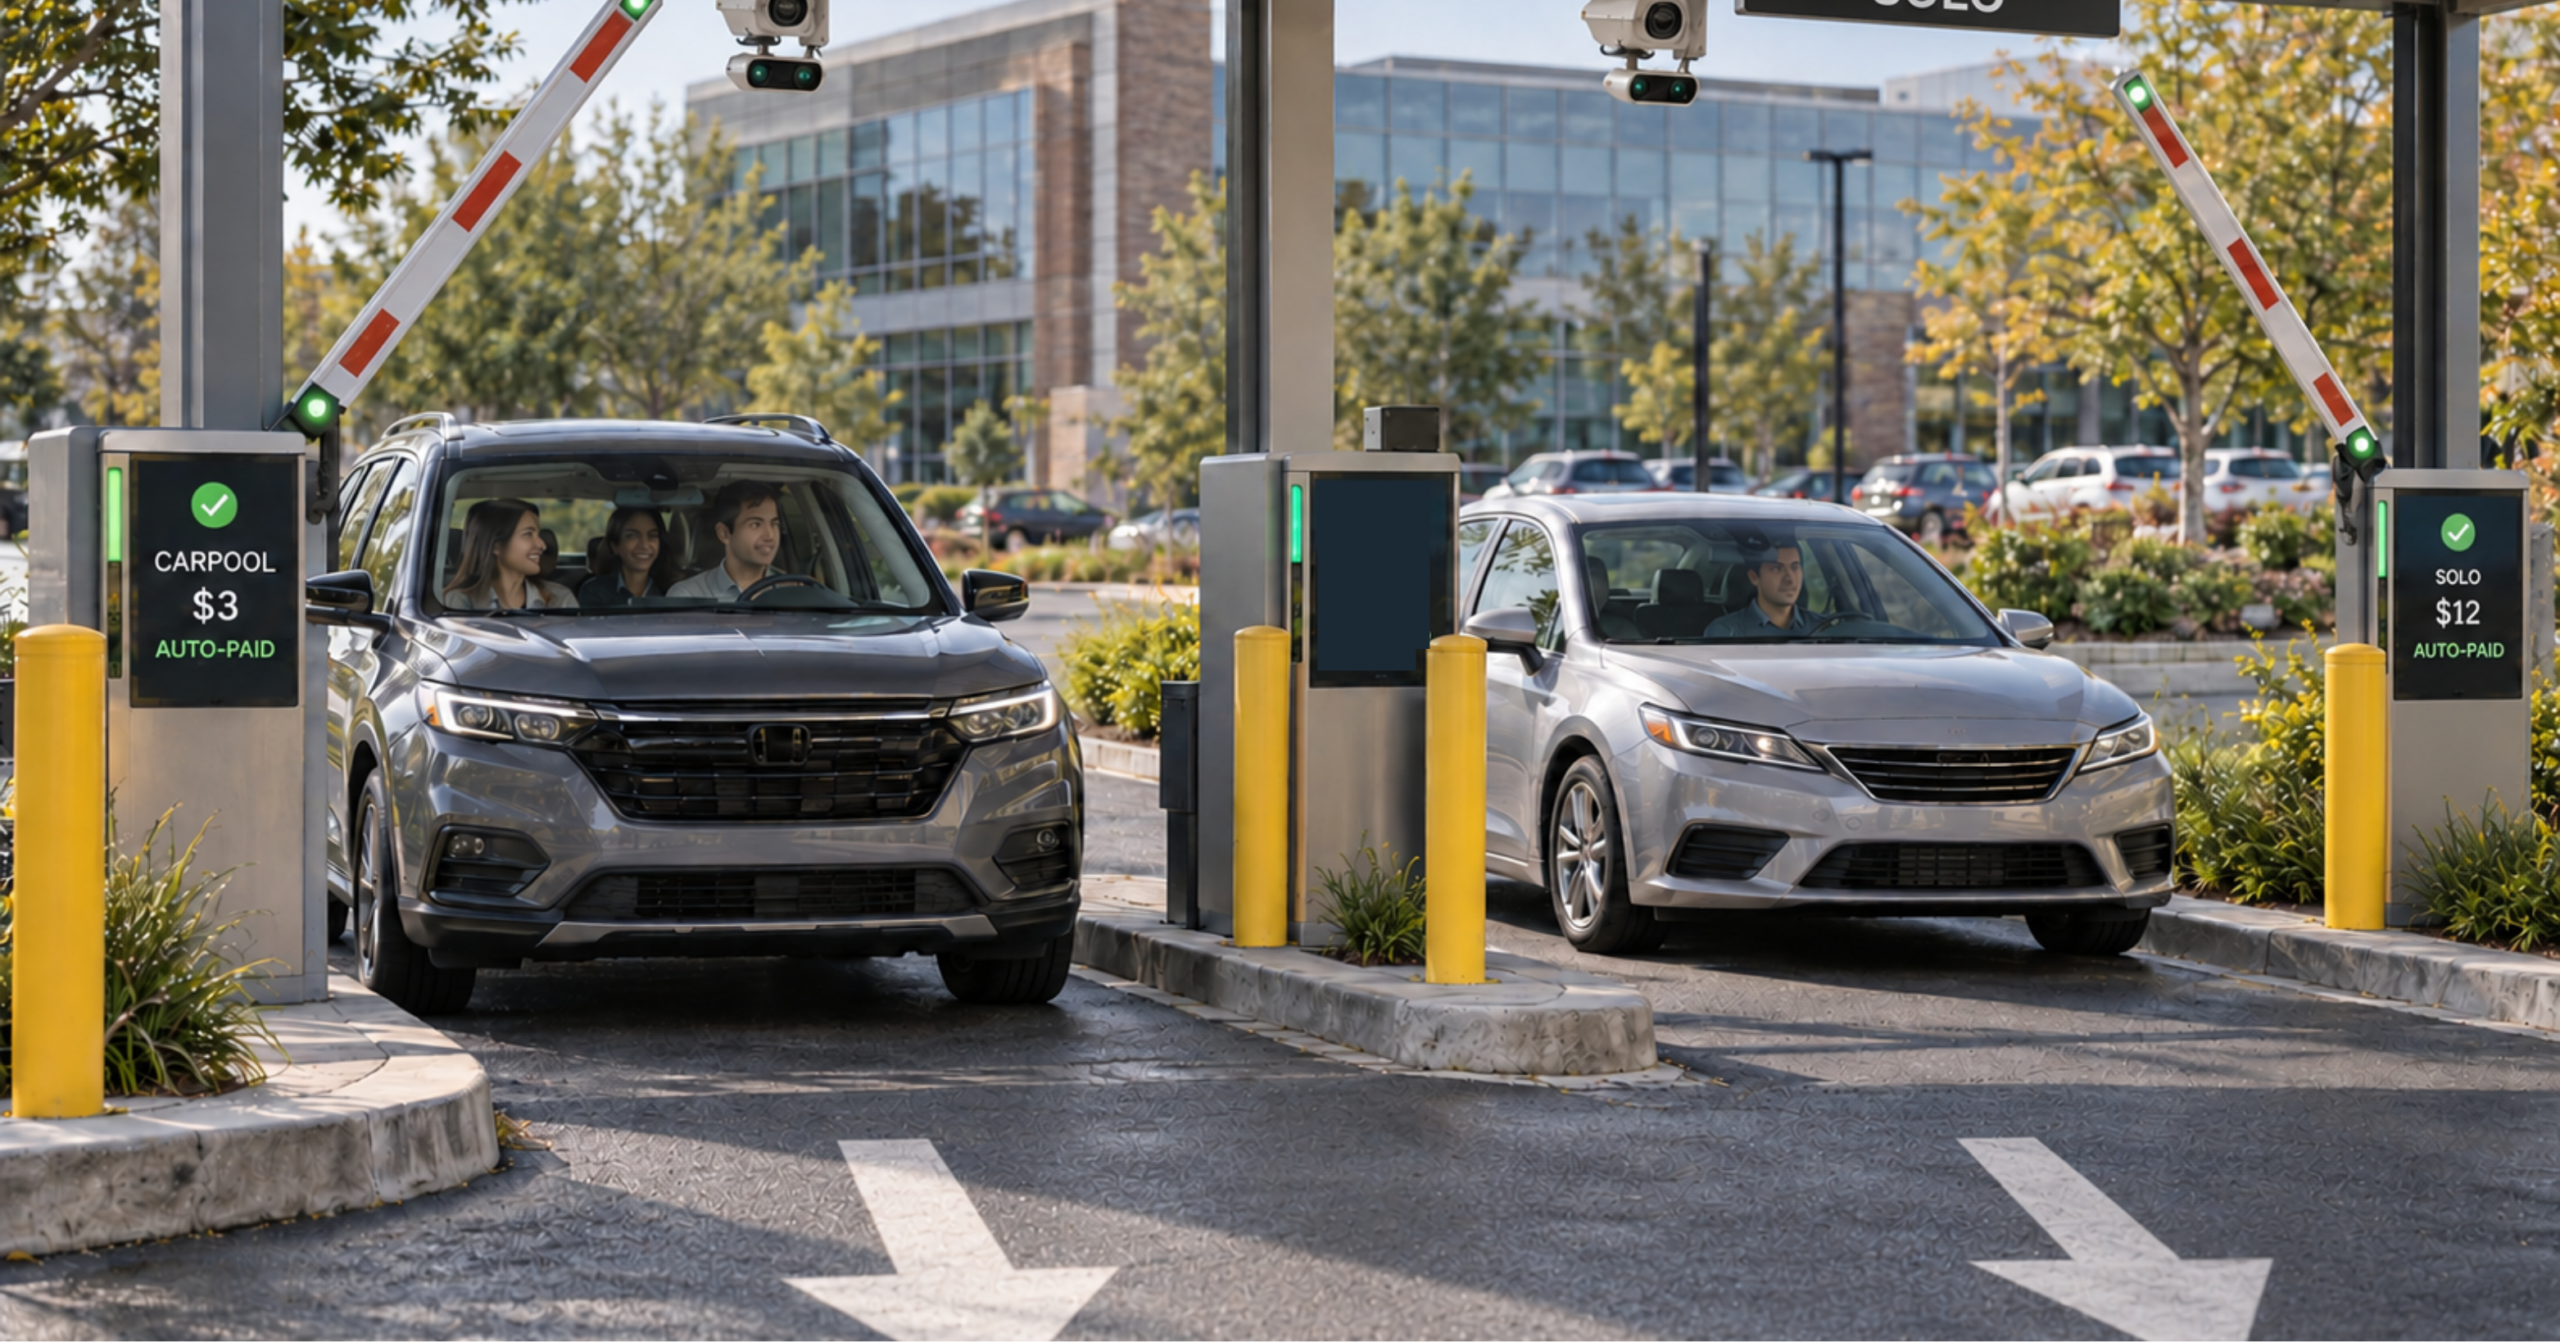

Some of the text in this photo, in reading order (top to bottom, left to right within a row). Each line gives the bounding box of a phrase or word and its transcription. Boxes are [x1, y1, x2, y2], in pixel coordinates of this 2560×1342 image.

[154, 550, 277, 573] CARPOOL
[2435, 568, 2482, 585] SOLO
[192, 586, 239, 625] $3
[2435, 596, 2481, 629] $12
[154, 639, 276, 659] AUTO-PAID
[2413, 642, 2505, 659] AUTO-PAID
